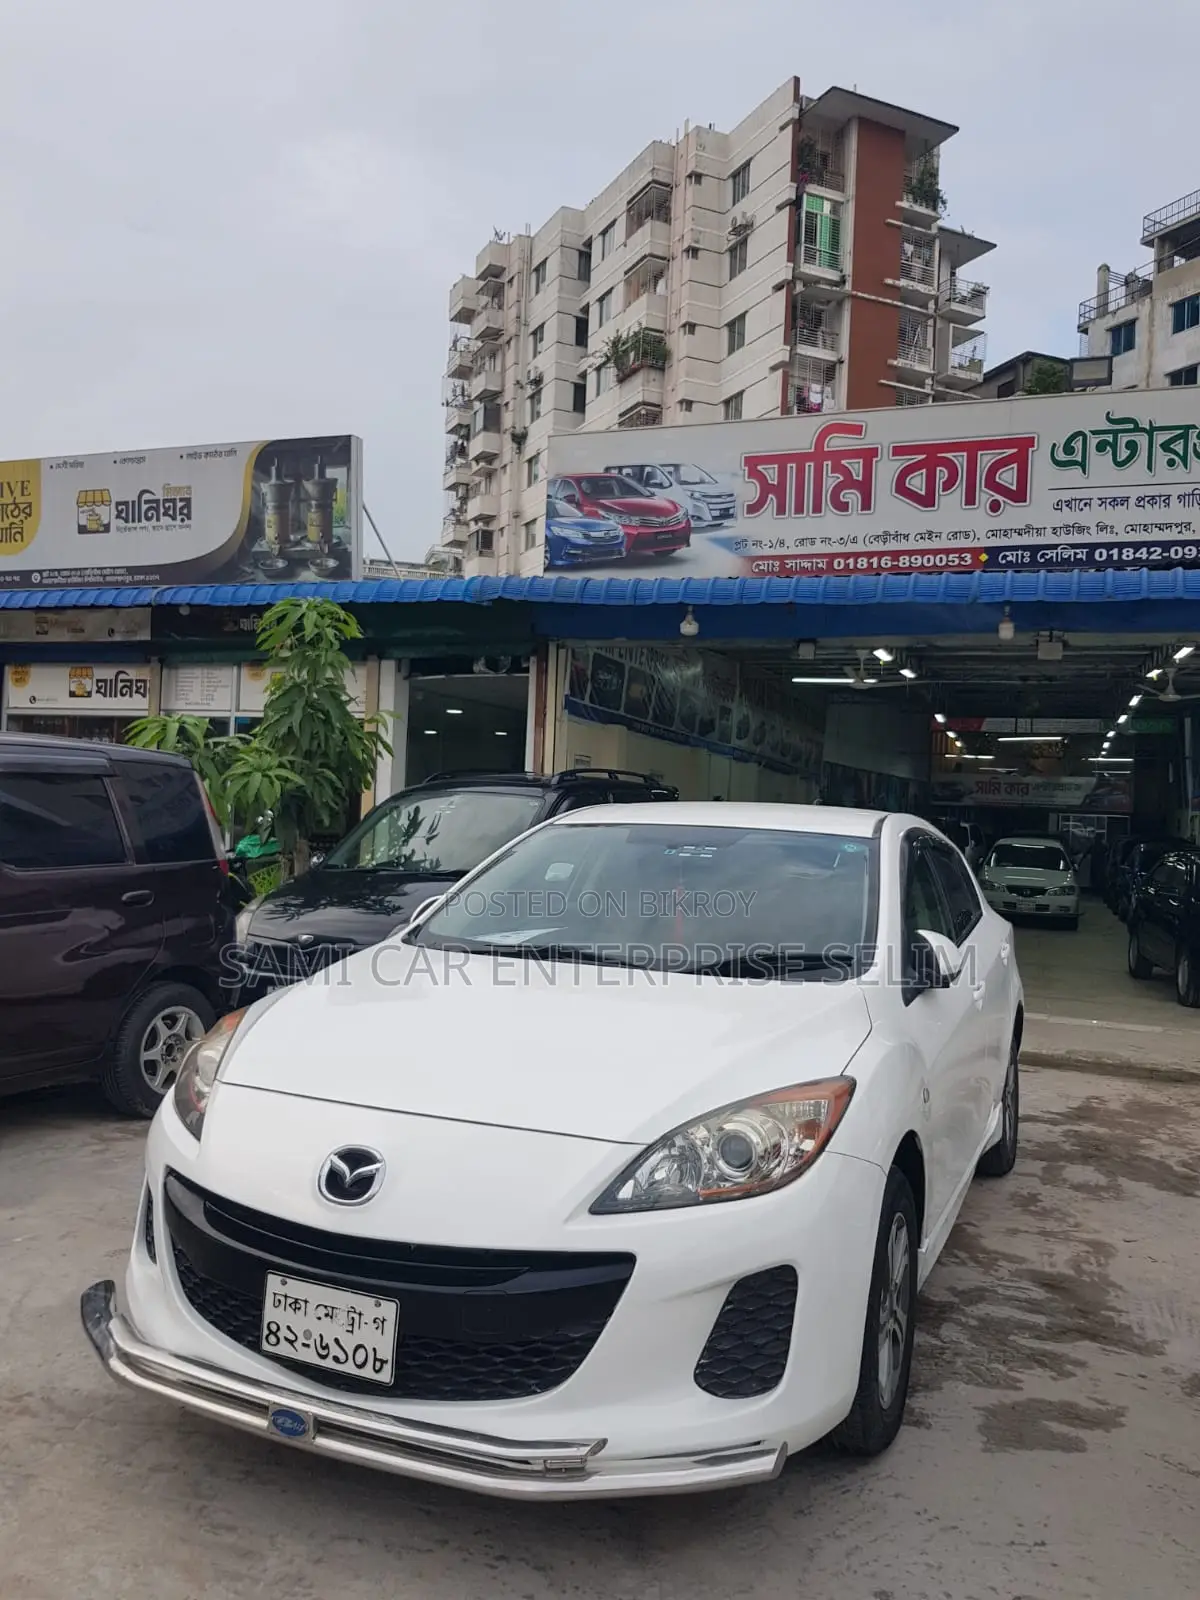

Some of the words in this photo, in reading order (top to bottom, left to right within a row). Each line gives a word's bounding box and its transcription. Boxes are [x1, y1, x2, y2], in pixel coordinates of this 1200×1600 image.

[742, 421, 881, 518] সামি
[891, 434, 1037, 516] কার
[1050, 410, 1200, 478] এন্টার
[115, 489, 192, 524] ঘানিঘর
[1053, 498, 1092, 514] এখানে
[1097, 496, 1129, 511] সকল
[1135, 494, 1172, 511] প্রকার
[794, 536, 817, 548] রোড
[913, 529, 943, 544] মেইন
[1051, 522, 1092, 538] হাউজিং
[1124, 520, 1196, 537] মোহাম্মদপুর,
[752, 559, 780, 573] মোঃ
[784, 557, 829, 572] সাদ্দাম
[832, 552, 972, 571] 01816-890053
[998, 550, 1031, 565] মোঃ
[1037, 545, 1089, 563] সেলিম
[1094, 545, 1200, 562] 01842-09
[95, 670, 149, 698] ঘানিঘ
[272, 1291, 310, 1317] ঢাকা
[265, 1321, 388, 1375] ৪২-৬১০৮
